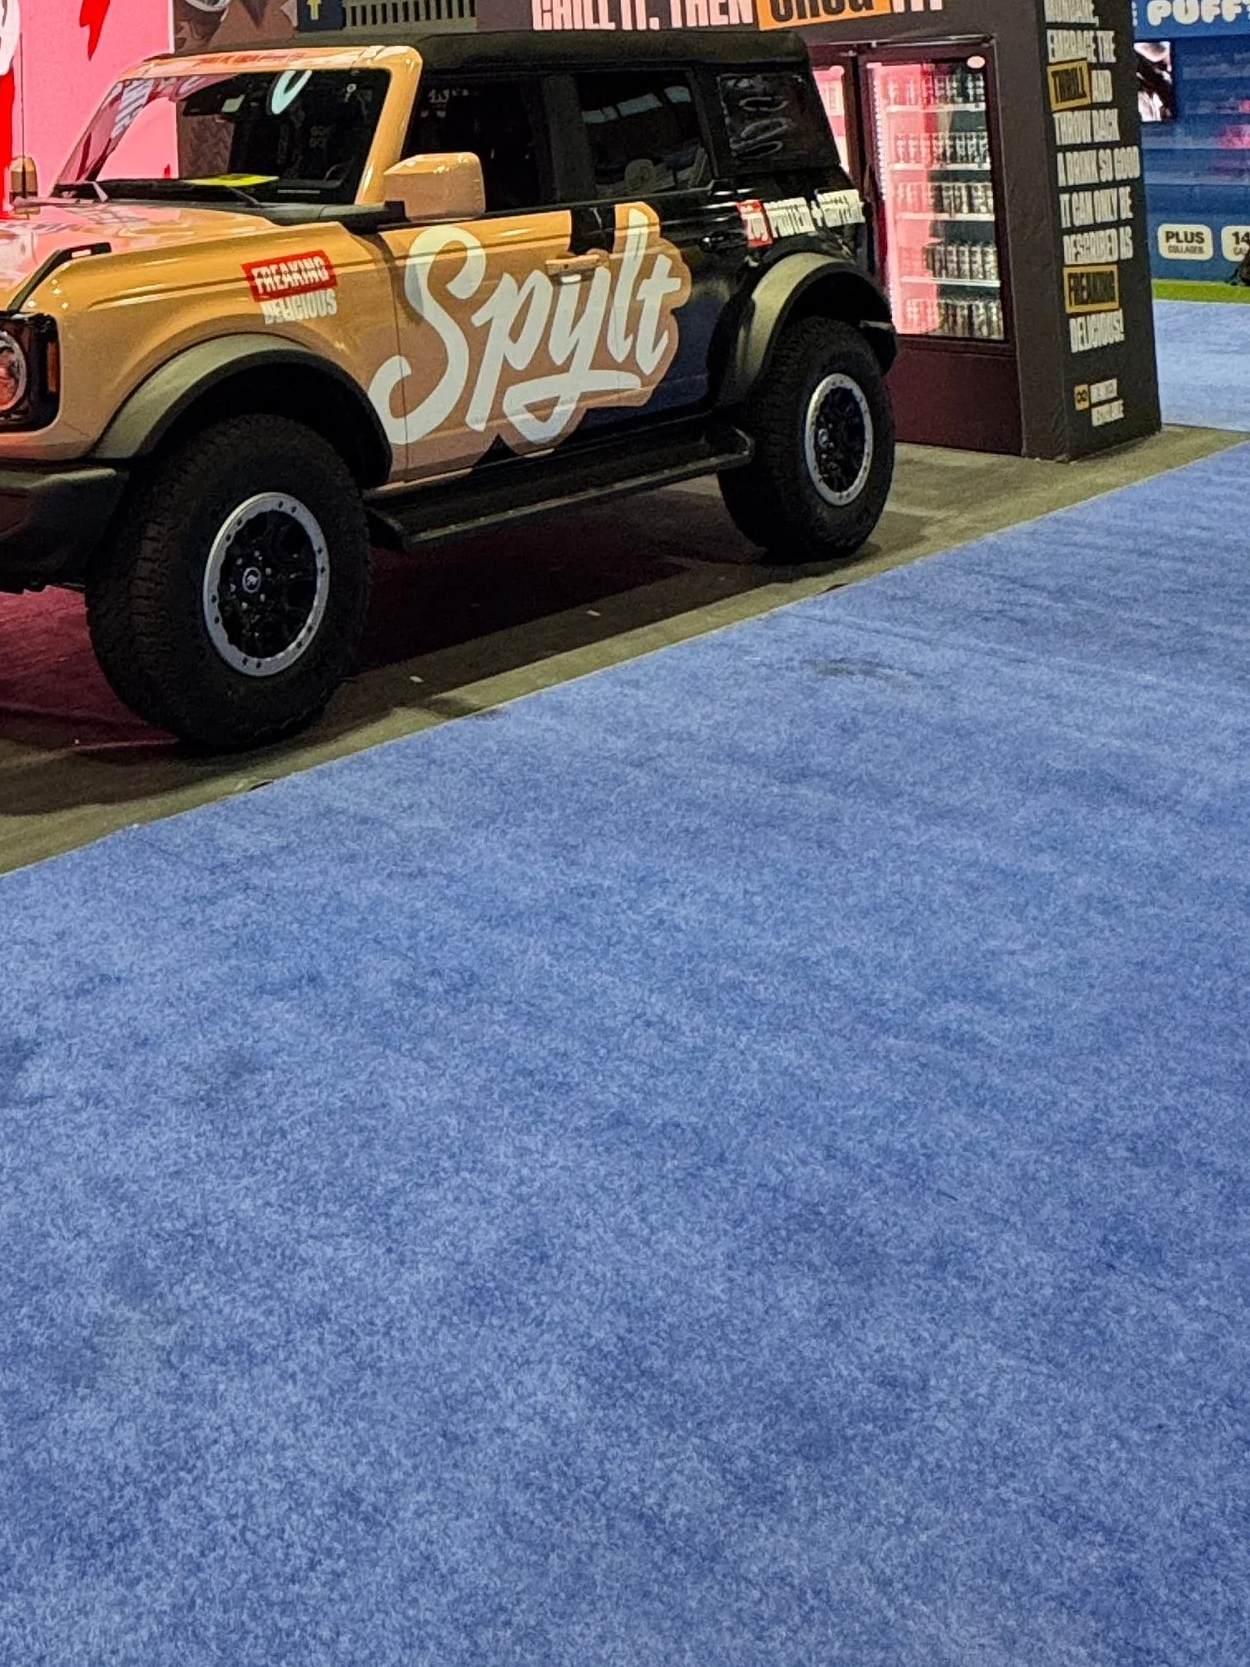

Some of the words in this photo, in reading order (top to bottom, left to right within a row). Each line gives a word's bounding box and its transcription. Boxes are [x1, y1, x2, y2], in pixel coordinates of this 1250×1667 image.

[1165, 230, 1205, 244] PLUS
[251, 256, 330, 294] FREAKING
[260, 288, 337, 325] DELICIOUS
[368, 207, 683, 445] Spylt
